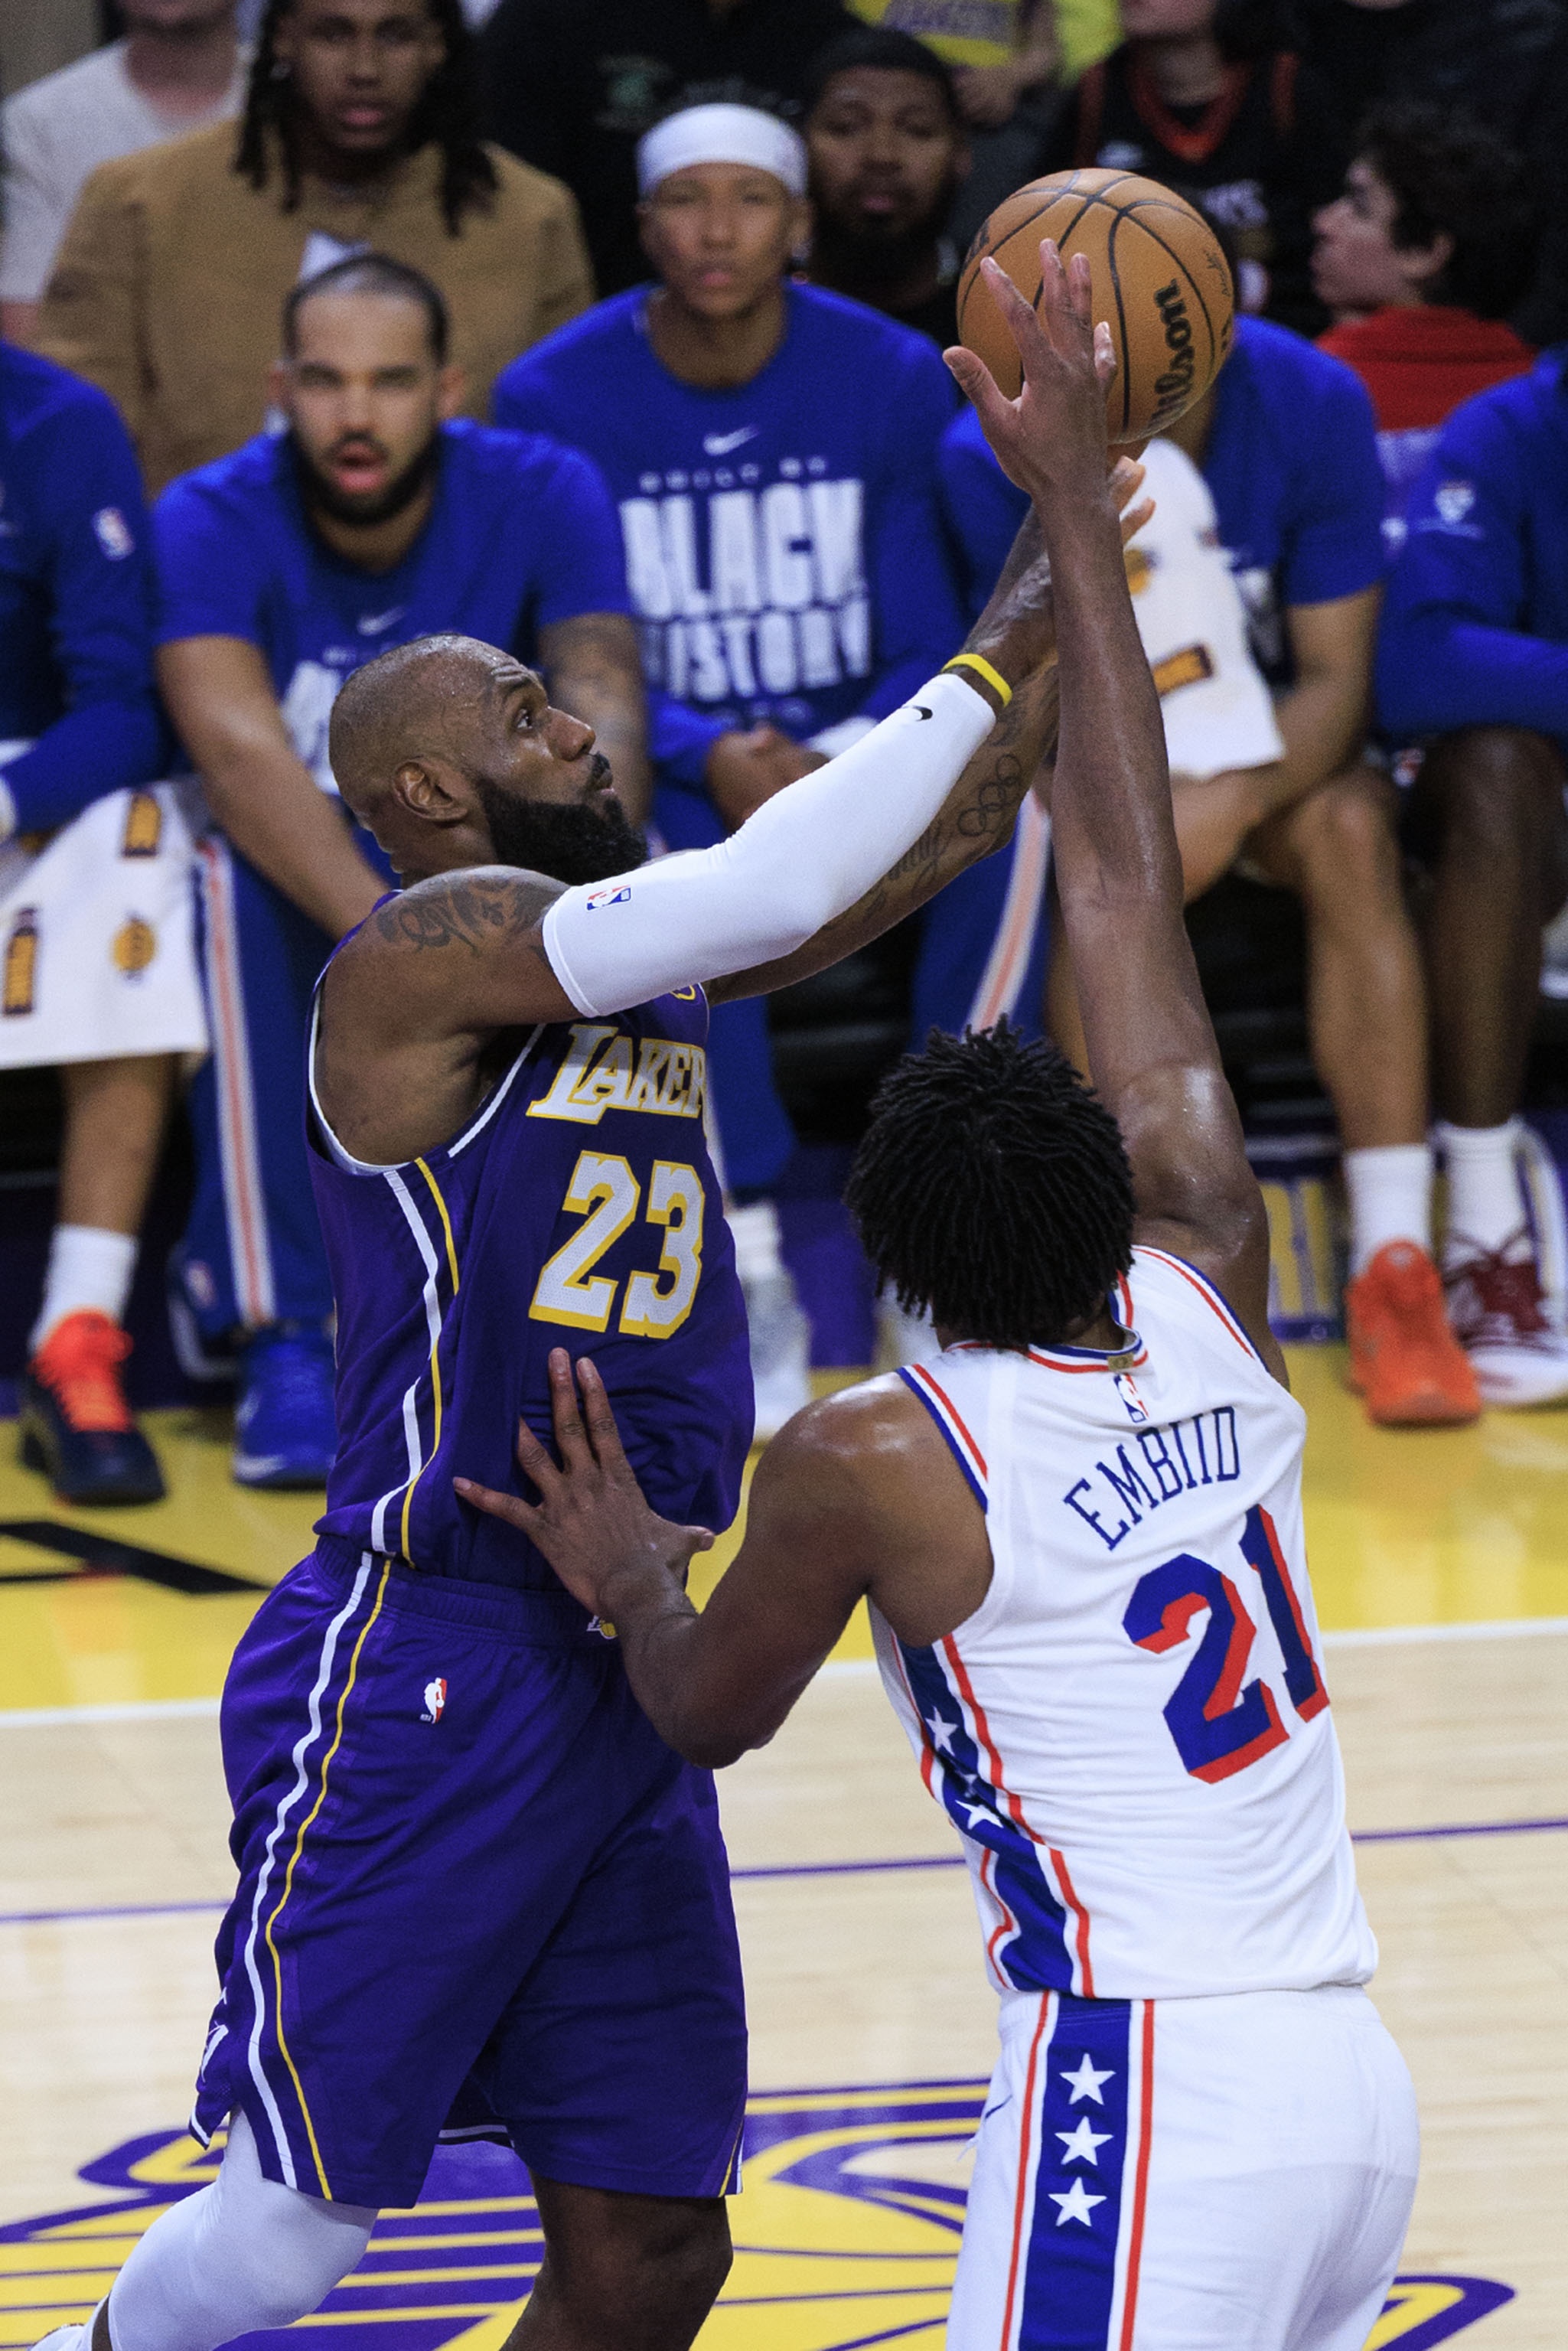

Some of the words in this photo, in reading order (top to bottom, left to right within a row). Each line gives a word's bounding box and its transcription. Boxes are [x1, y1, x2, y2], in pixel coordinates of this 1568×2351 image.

[644, 597, 871, 699] ISTORY
[526, 1024, 707, 1131] LAKER
[528, 1150, 706, 1339] 23
[1063, 1405, 1241, 1550] EMBIID
[1122, 1503, 1331, 1785] 21
